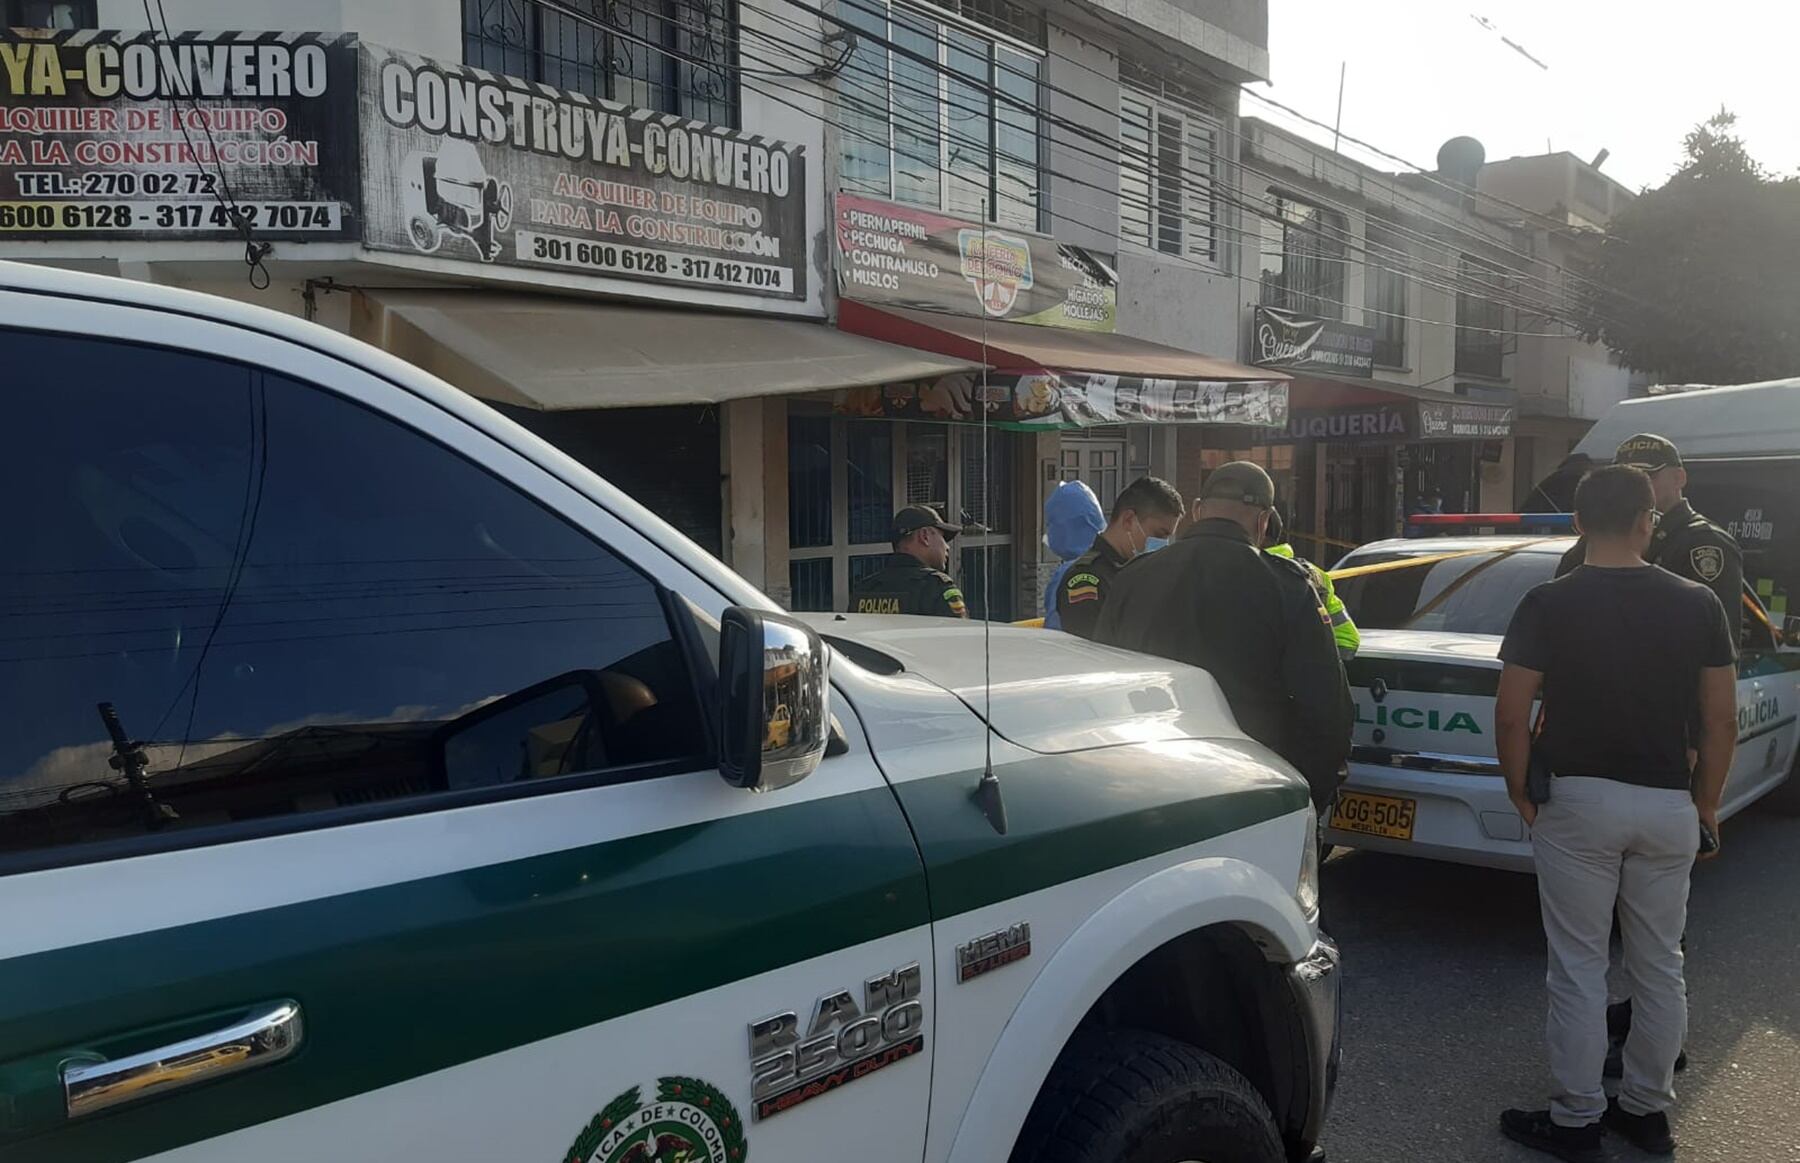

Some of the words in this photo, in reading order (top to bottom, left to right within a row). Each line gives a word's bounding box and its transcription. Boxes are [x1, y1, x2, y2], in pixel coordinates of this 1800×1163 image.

[127, 109, 162, 132] DE
[172, 108, 287, 133] EQUIPO
[381, 62, 789, 198] CONSTRUYA-CONVERO
[32, 141, 70, 165] LA
[75, 136, 319, 166] CONSTRUCCIÓN
[86, 174, 135, 194] 270
[143, 174, 181, 194] 02
[185, 173, 217, 194] 72
[553, 173, 657, 212] ALQUILER
[660, 192, 686, 214] DE
[691, 199, 762, 229] EQUIPO
[0, 205, 55, 228] 600
[62, 206, 131, 228] 6128
[157, 206, 203, 228] 317
[265, 206, 331, 228] 7074
[531, 198, 591, 230] PARA
[595, 209, 624, 236] LA
[627, 215, 780, 258] CONSTRUCCIÓN
[850, 210, 928, 241] PIERNAPERNIL
[851, 231, 905, 255] PECHUGA
[534, 237, 571, 261] 301
[577, 242, 616, 267] 600
[622, 250, 667, 273] 6128
[682, 258, 710, 280] 317
[714, 263, 742, 284] 412
[745, 266, 781, 287] 7074
[852, 250, 938, 278] CONTRAMUSLO
[853, 269, 899, 290] MUSLOS
[858, 598, 900, 614] POLICIA
[748, 960, 921, 1058] RAM
[752, 1000, 923, 1098] 2500
[763, 1069, 848, 1116] HEAVY
[853, 1041, 917, 1077] DUTY
[641, 1106, 663, 1123] DE
